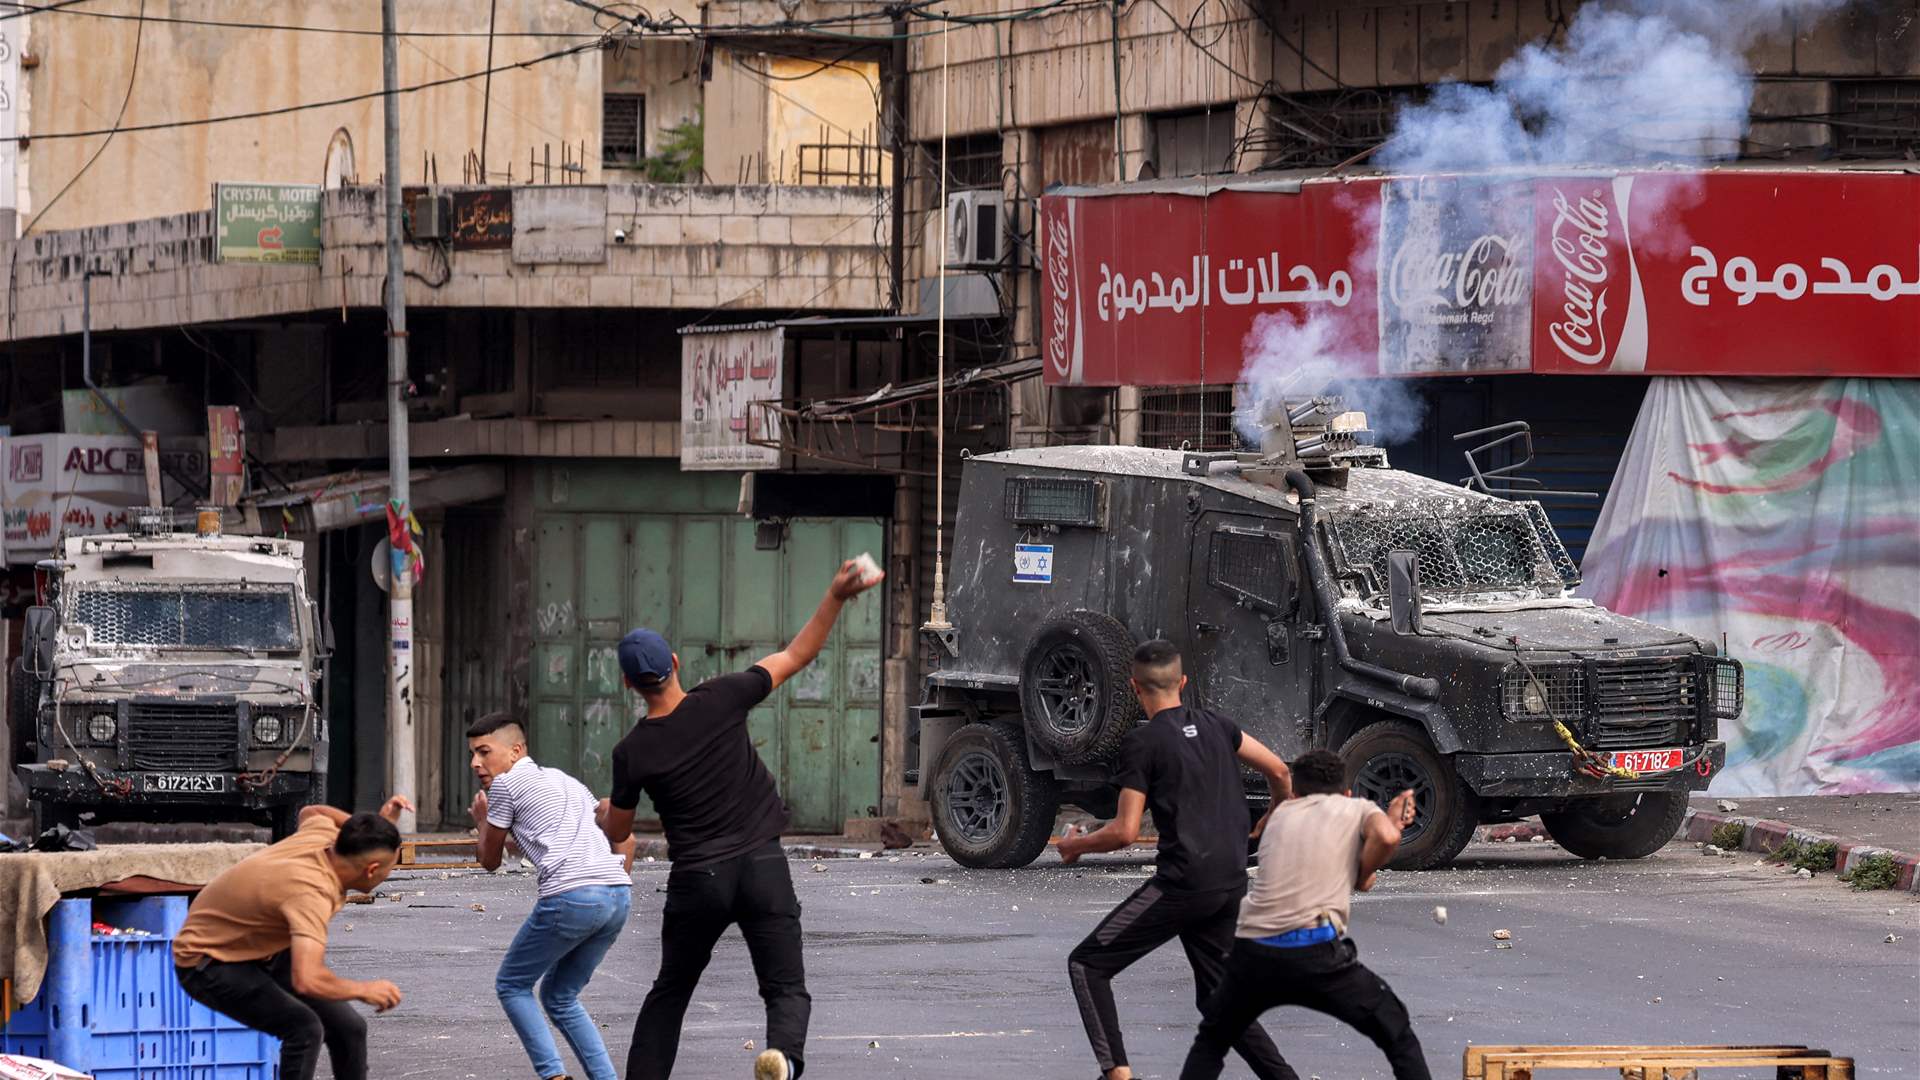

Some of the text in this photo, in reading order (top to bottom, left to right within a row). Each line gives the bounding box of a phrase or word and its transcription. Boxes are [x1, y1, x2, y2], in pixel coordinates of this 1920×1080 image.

[223, 188, 319, 202] CRYSTAL MOTEL
[1047, 209, 1069, 377] Coca-Cola
[1097, 251, 1353, 322] محلات المدموج
[1548, 187, 1609, 365] Coca-Cola
[1681, 243, 1920, 306] مدموج
[1424, 311, 1469, 324] rademark
[64, 446, 200, 474] APC PANTS
[1624, 752, 1671, 771] 61-7182
